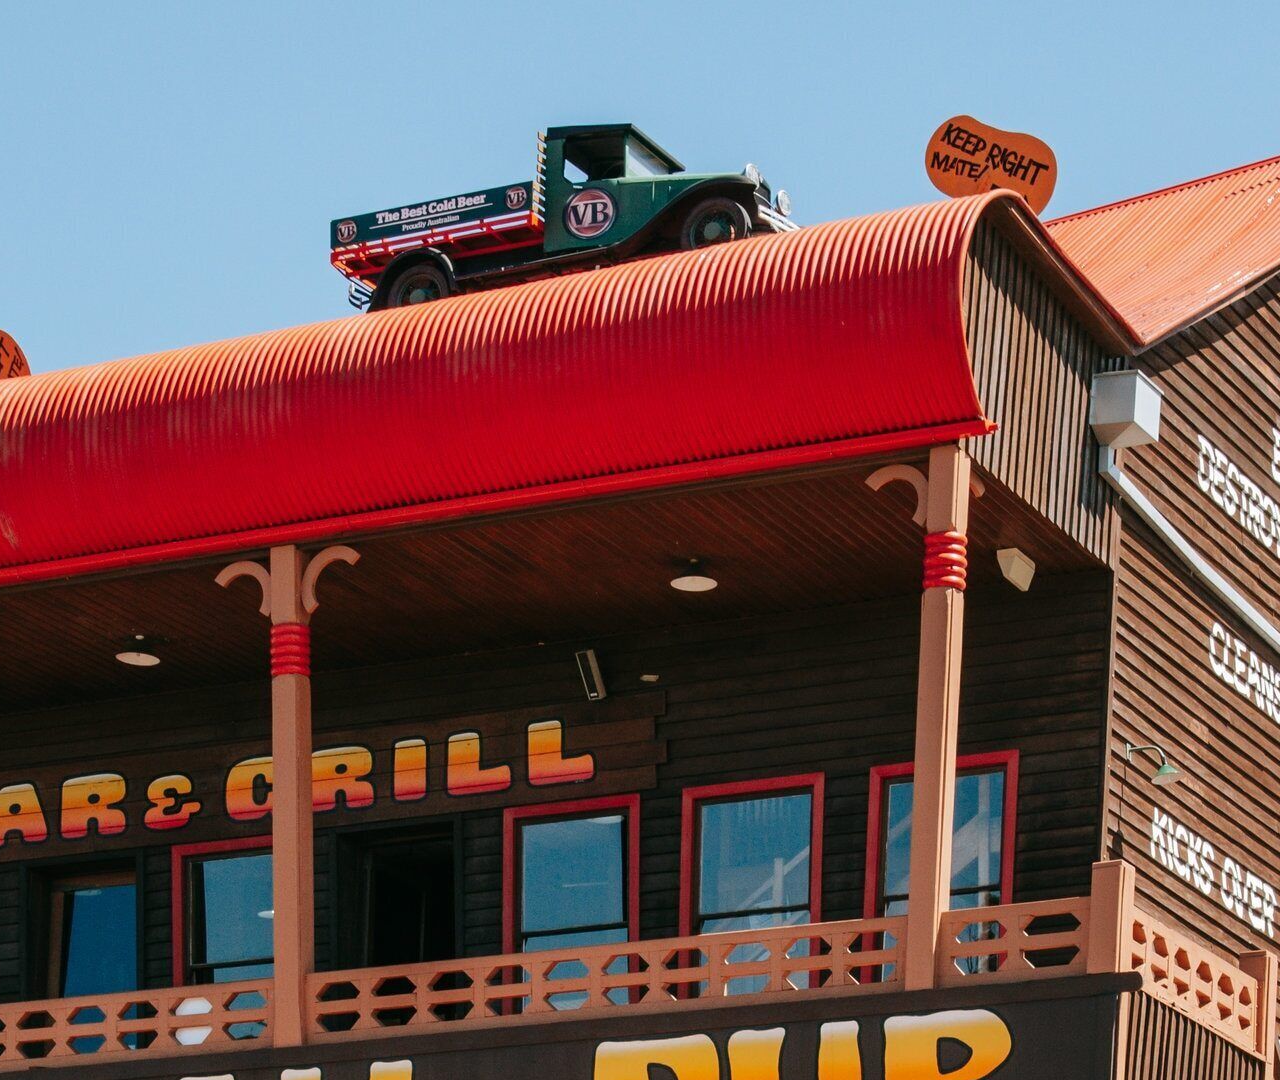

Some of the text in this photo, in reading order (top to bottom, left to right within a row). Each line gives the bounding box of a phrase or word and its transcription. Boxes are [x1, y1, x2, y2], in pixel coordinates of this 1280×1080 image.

[930, 152, 989, 182] MATE!
[940, 123, 1049, 186] KEEP RIGHT
[376, 193, 487, 225] The Best Cold Beer
[506, 188, 527, 206] VB
[402, 213, 460, 232] Proudly Australian
[569, 201, 611, 227] VB
[338, 223, 357, 240] VB
[7, 346, 24, 378] TE!
[144, 774, 202, 830] &
[1149, 806, 1215, 897] KICKS
[1220, 856, 1276, 941] OVER
